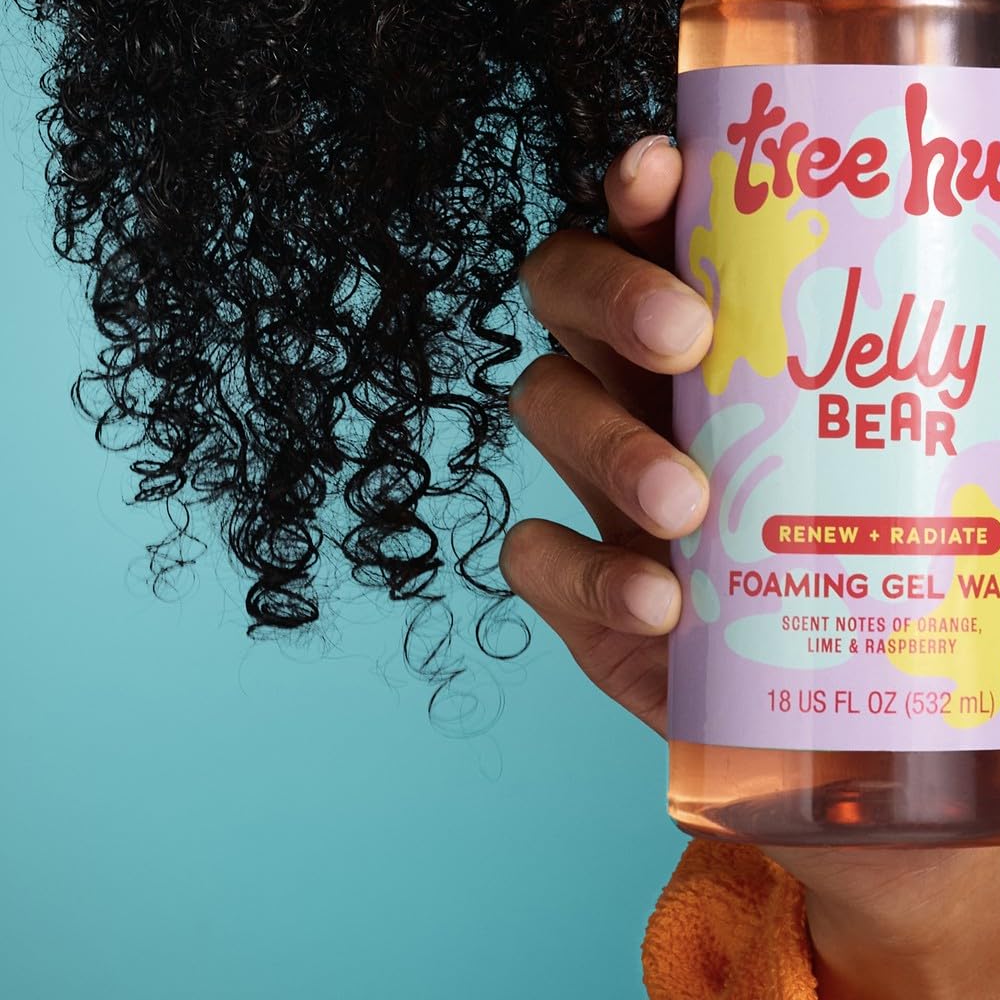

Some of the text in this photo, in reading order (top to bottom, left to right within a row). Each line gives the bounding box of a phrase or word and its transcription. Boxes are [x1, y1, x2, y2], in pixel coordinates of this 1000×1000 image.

[727, 82, 890, 215] tree
[786, 266, 986, 410] Jelly
[818, 392, 957, 456] BEAR
[779, 525, 988, 545] RENEW + RADIATE
[729, 570, 868, 599] FOAMING
[882, 574, 945, 600] GEL
[782, 615, 982, 635] SCENT NOTES OF ORANGE,
[807, 638, 957, 655] LIME & RASPBERRY
[767, 688, 995, 719] 18 US FL OZ (532 mL)
